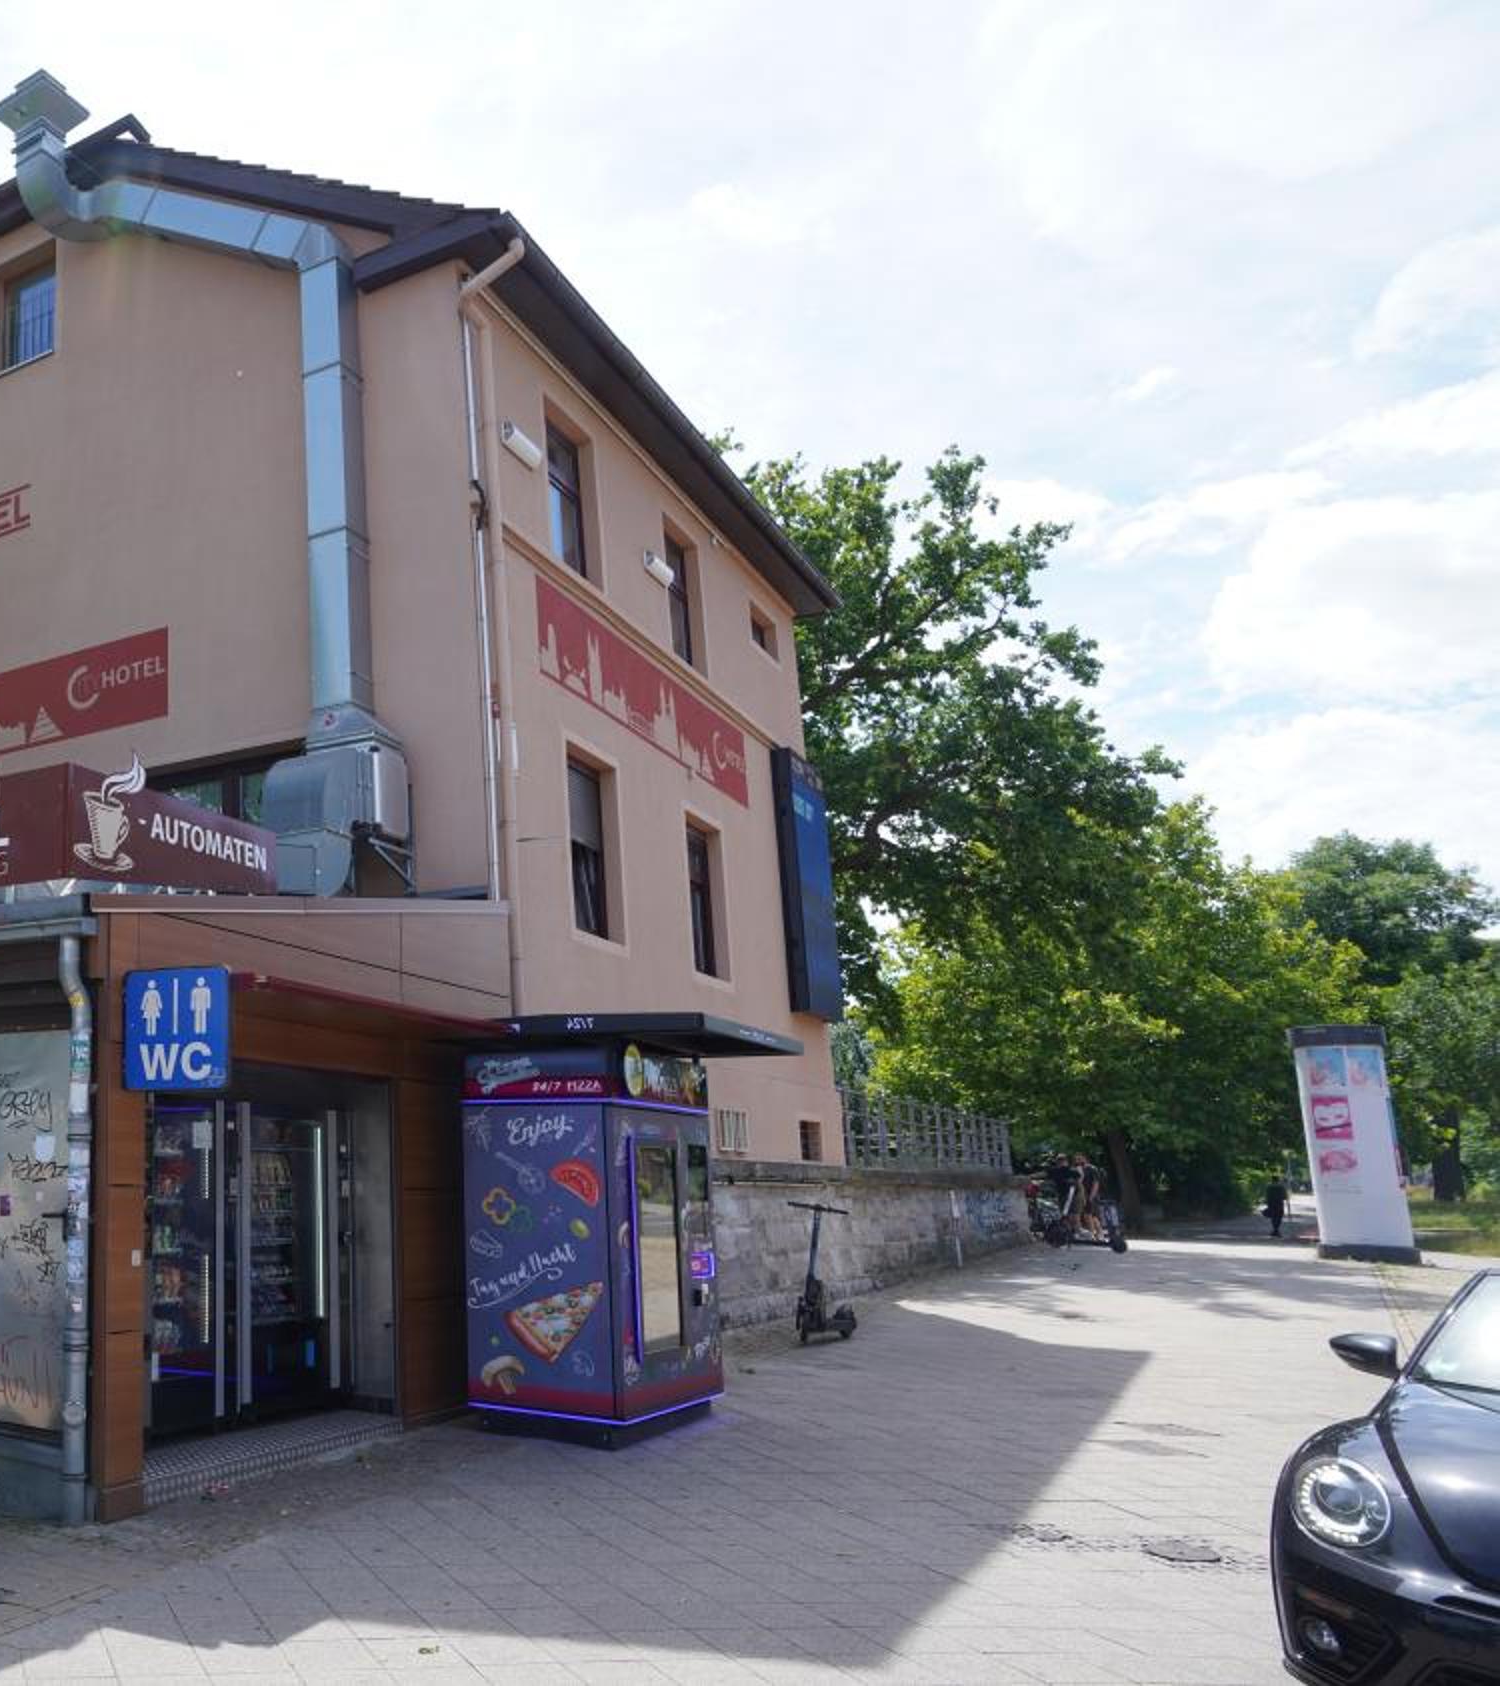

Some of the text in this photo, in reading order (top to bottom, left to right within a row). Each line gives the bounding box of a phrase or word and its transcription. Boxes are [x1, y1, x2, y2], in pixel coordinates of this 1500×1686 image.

[151, 813, 268, 872] AUTOMATEN
[140, 1041, 212, 1081] WC
[507, 1114, 575, 1147] Enjoy
[469, 1277, 501, 1297] Tag
[529, 1243, 578, 1272] Nacht
